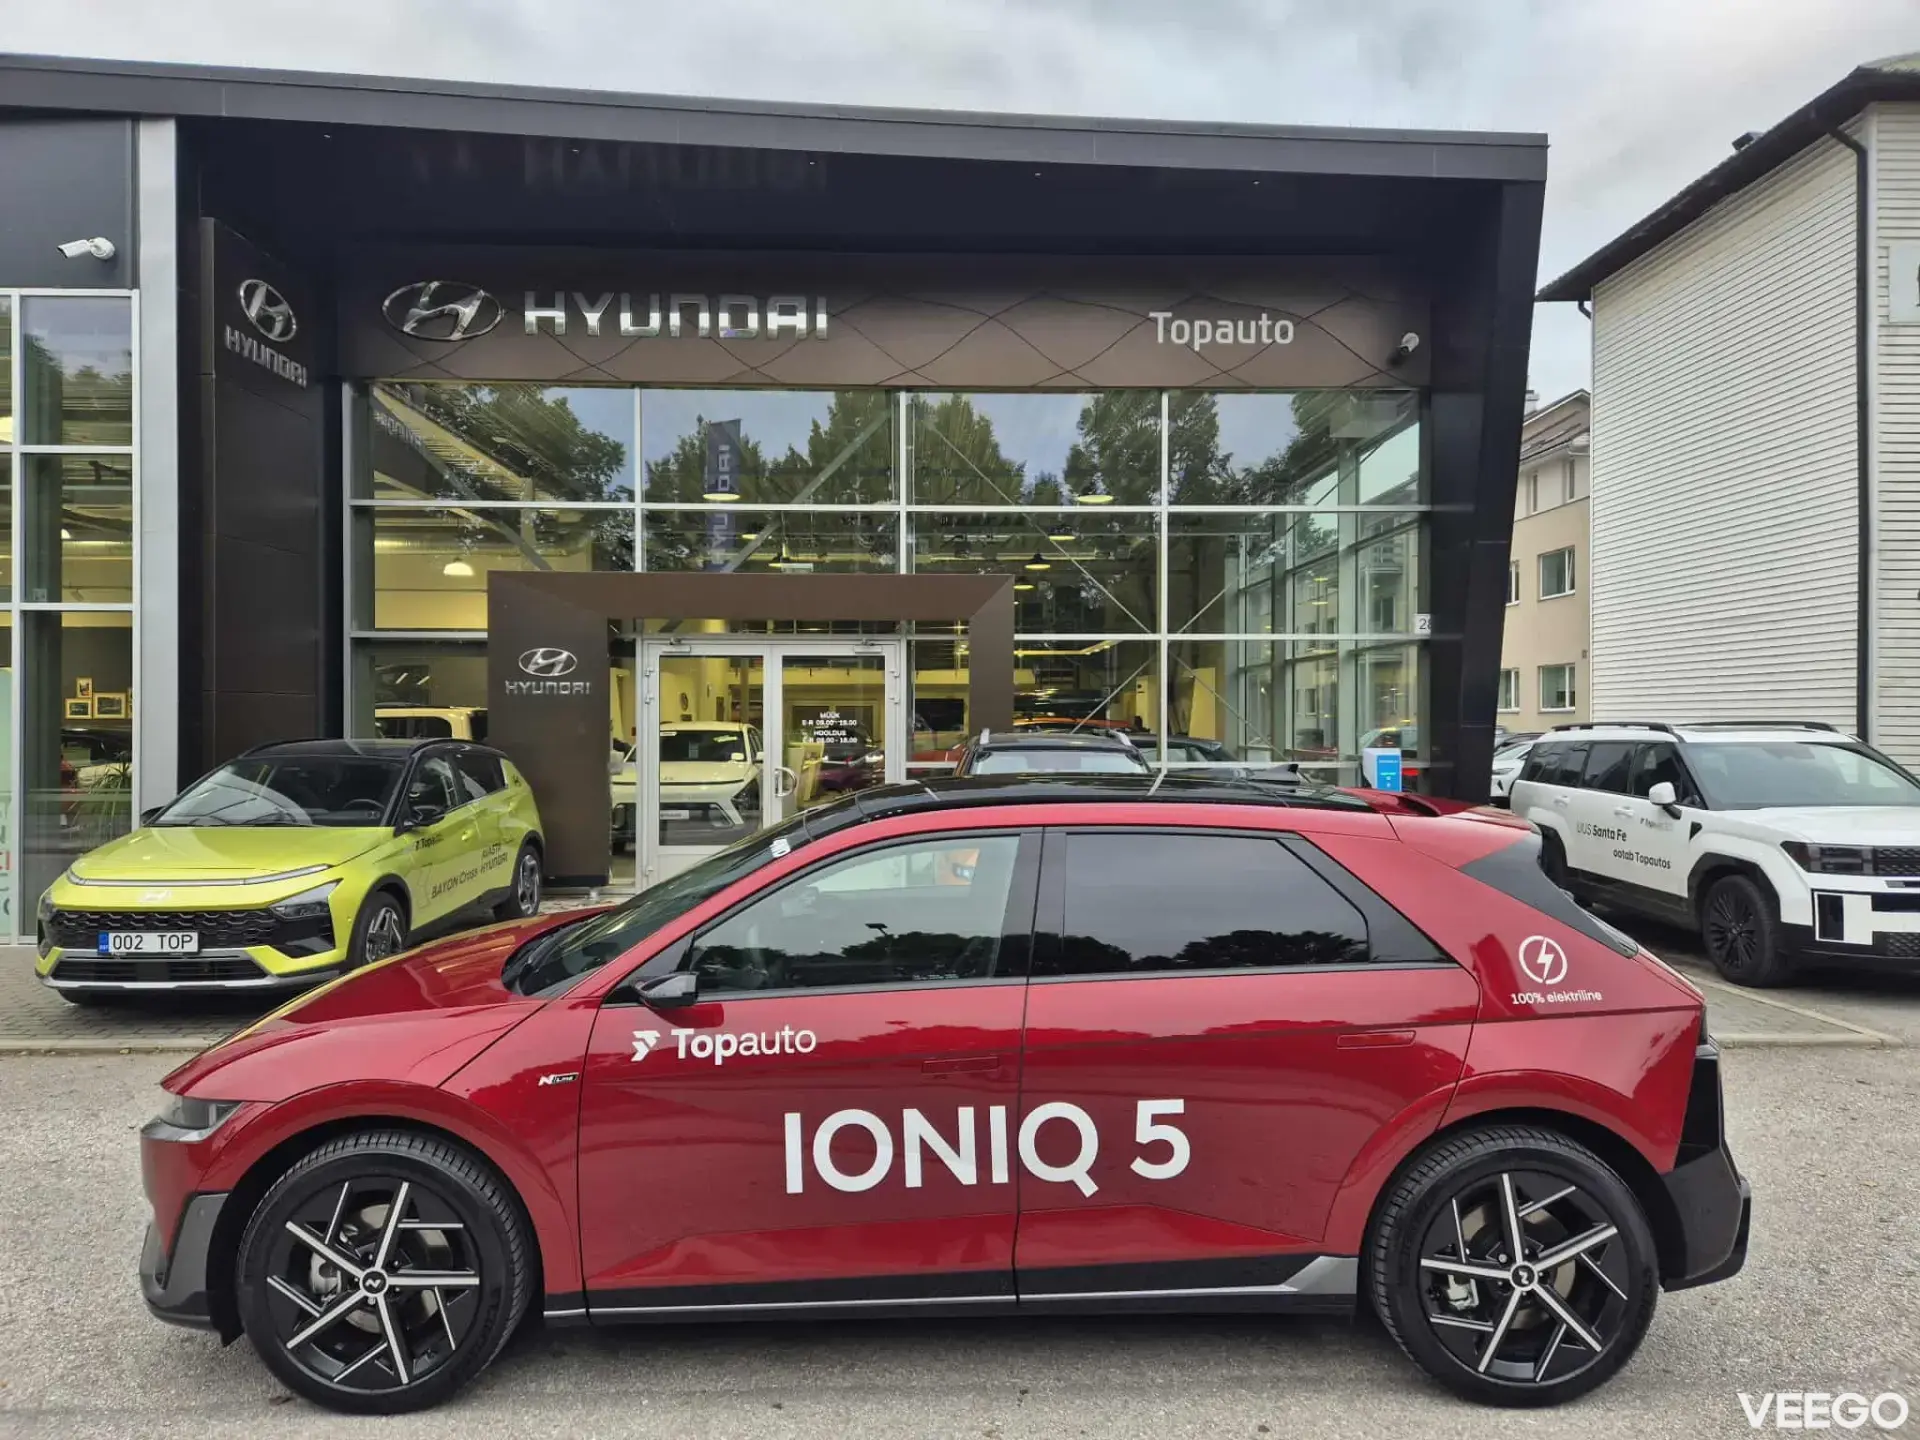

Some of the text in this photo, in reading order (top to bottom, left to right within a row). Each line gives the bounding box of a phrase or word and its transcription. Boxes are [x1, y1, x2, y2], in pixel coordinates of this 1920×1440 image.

[524, 291, 828, 340] HYUNDAI
[1148, 311, 1295, 352] Topauto
[225, 323, 307, 389] HYUNDAI
[505, 680, 591, 695] HYUNDAI
[1592, 824, 1615, 840] Santa
[1616, 829, 1627, 842] Fe
[1634, 852, 1671, 870] Topautos
[431, 876, 459, 899] BAYON
[112, 934, 193, 950] 002 TOP
[1511, 990, 1603, 1005] 100% elektriline
[670, 1024, 817, 1066] Topauto
[784, 1098, 1191, 1198] IONIQ 5
